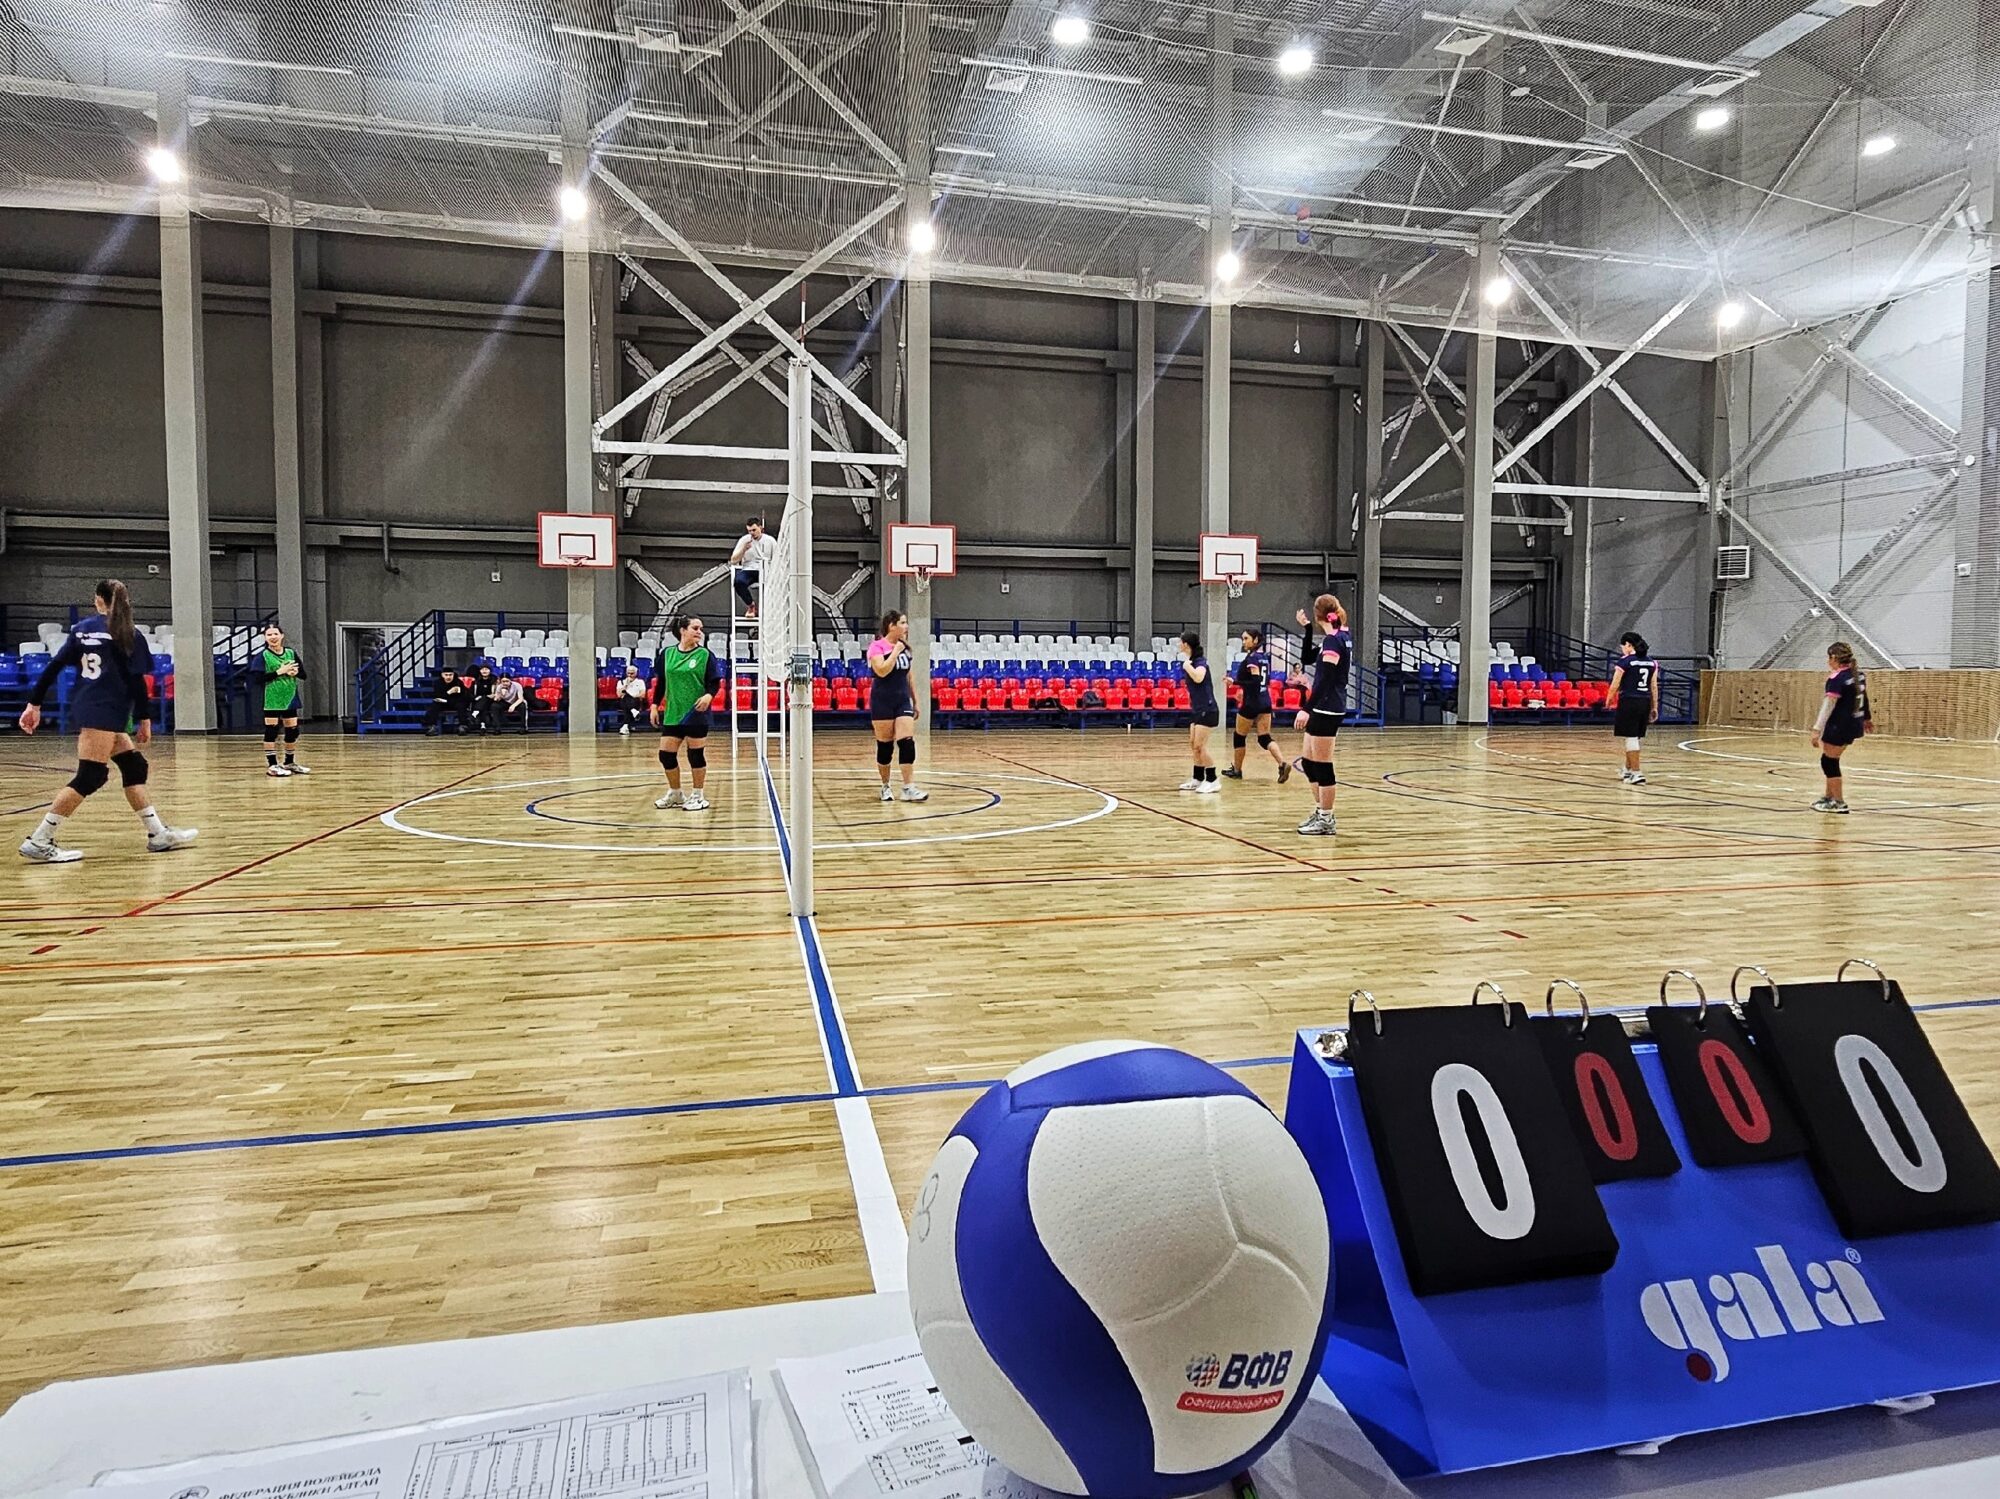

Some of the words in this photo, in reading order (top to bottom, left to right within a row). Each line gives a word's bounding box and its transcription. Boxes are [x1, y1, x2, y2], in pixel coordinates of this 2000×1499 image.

[81, 652, 102, 680] 13
[1637, 667, 1649, 687] 3
[1574, 1052, 1639, 1161] 0
[1699, 1039, 1772, 1143] 0
[1834, 1034, 1948, 1193] 0
[1431, 1063, 1535, 1240] 0
[1640, 1244, 1886, 1383] gala
[1218, 1350, 1293, 1389] ВФВ
